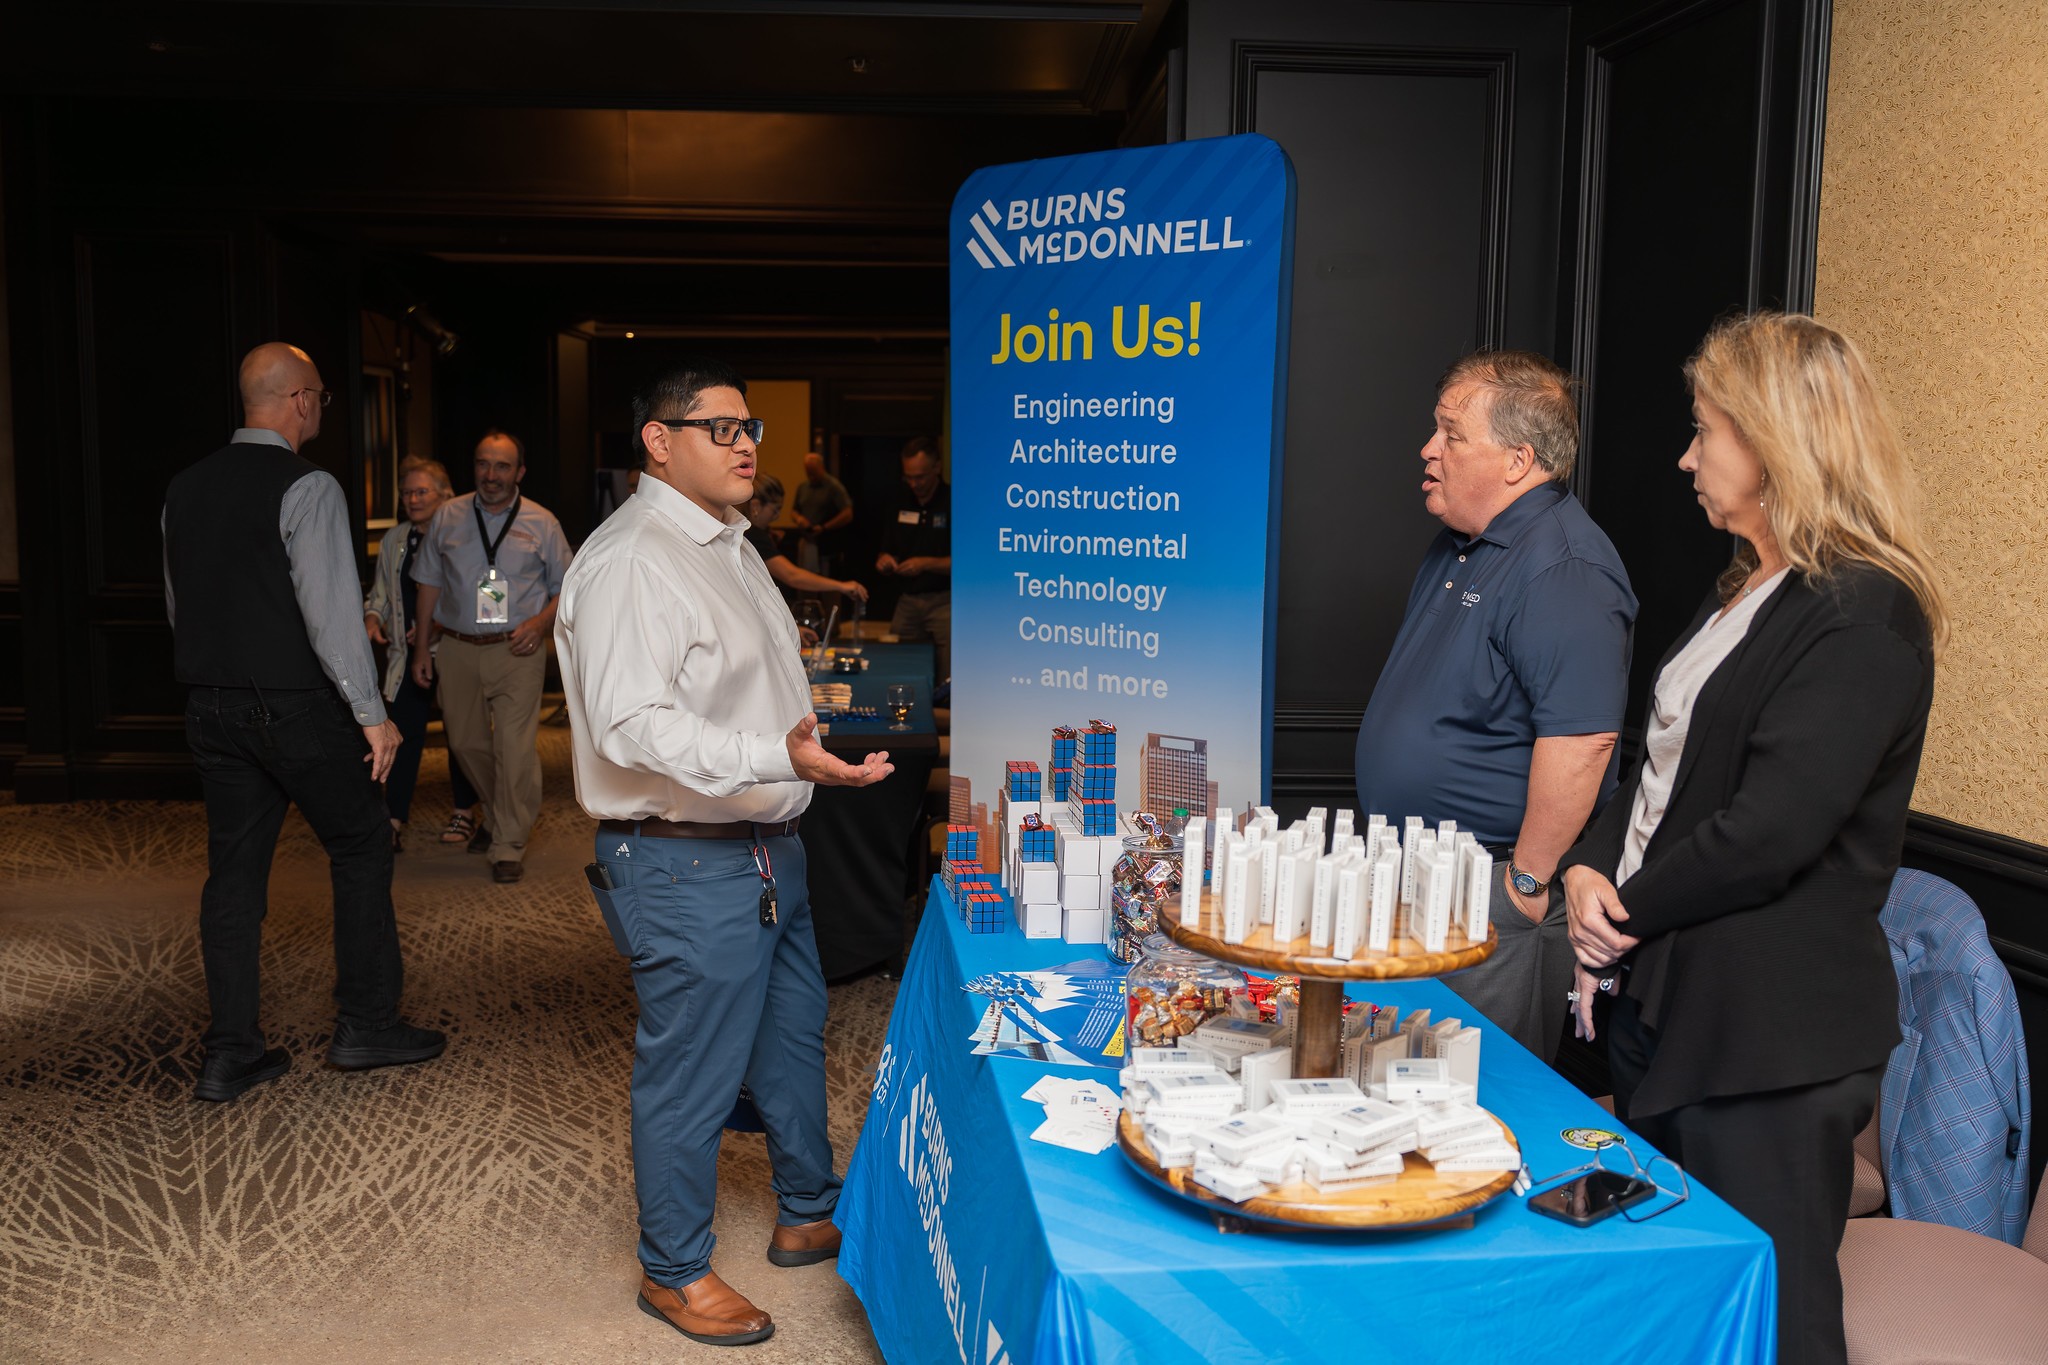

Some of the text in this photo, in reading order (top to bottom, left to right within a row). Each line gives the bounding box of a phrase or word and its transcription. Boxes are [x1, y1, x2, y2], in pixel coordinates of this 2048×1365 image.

[1007, 188, 1126, 231] BURNS
[992, 301, 1201, 364] Join Us!
[1014, 391, 1175, 424] Engineering
[1010, 438, 1177, 464] Architecture
[1006, 484, 1180, 511] Construction
[999, 528, 1187, 559] Environmental
[1014, 572, 1167, 611] Technology
[1019, 617, 1159, 657] Consulting
[1040, 667, 1088, 690] and
[1098, 673, 1168, 698] more
[922, 1092, 952, 1205] BURNS
